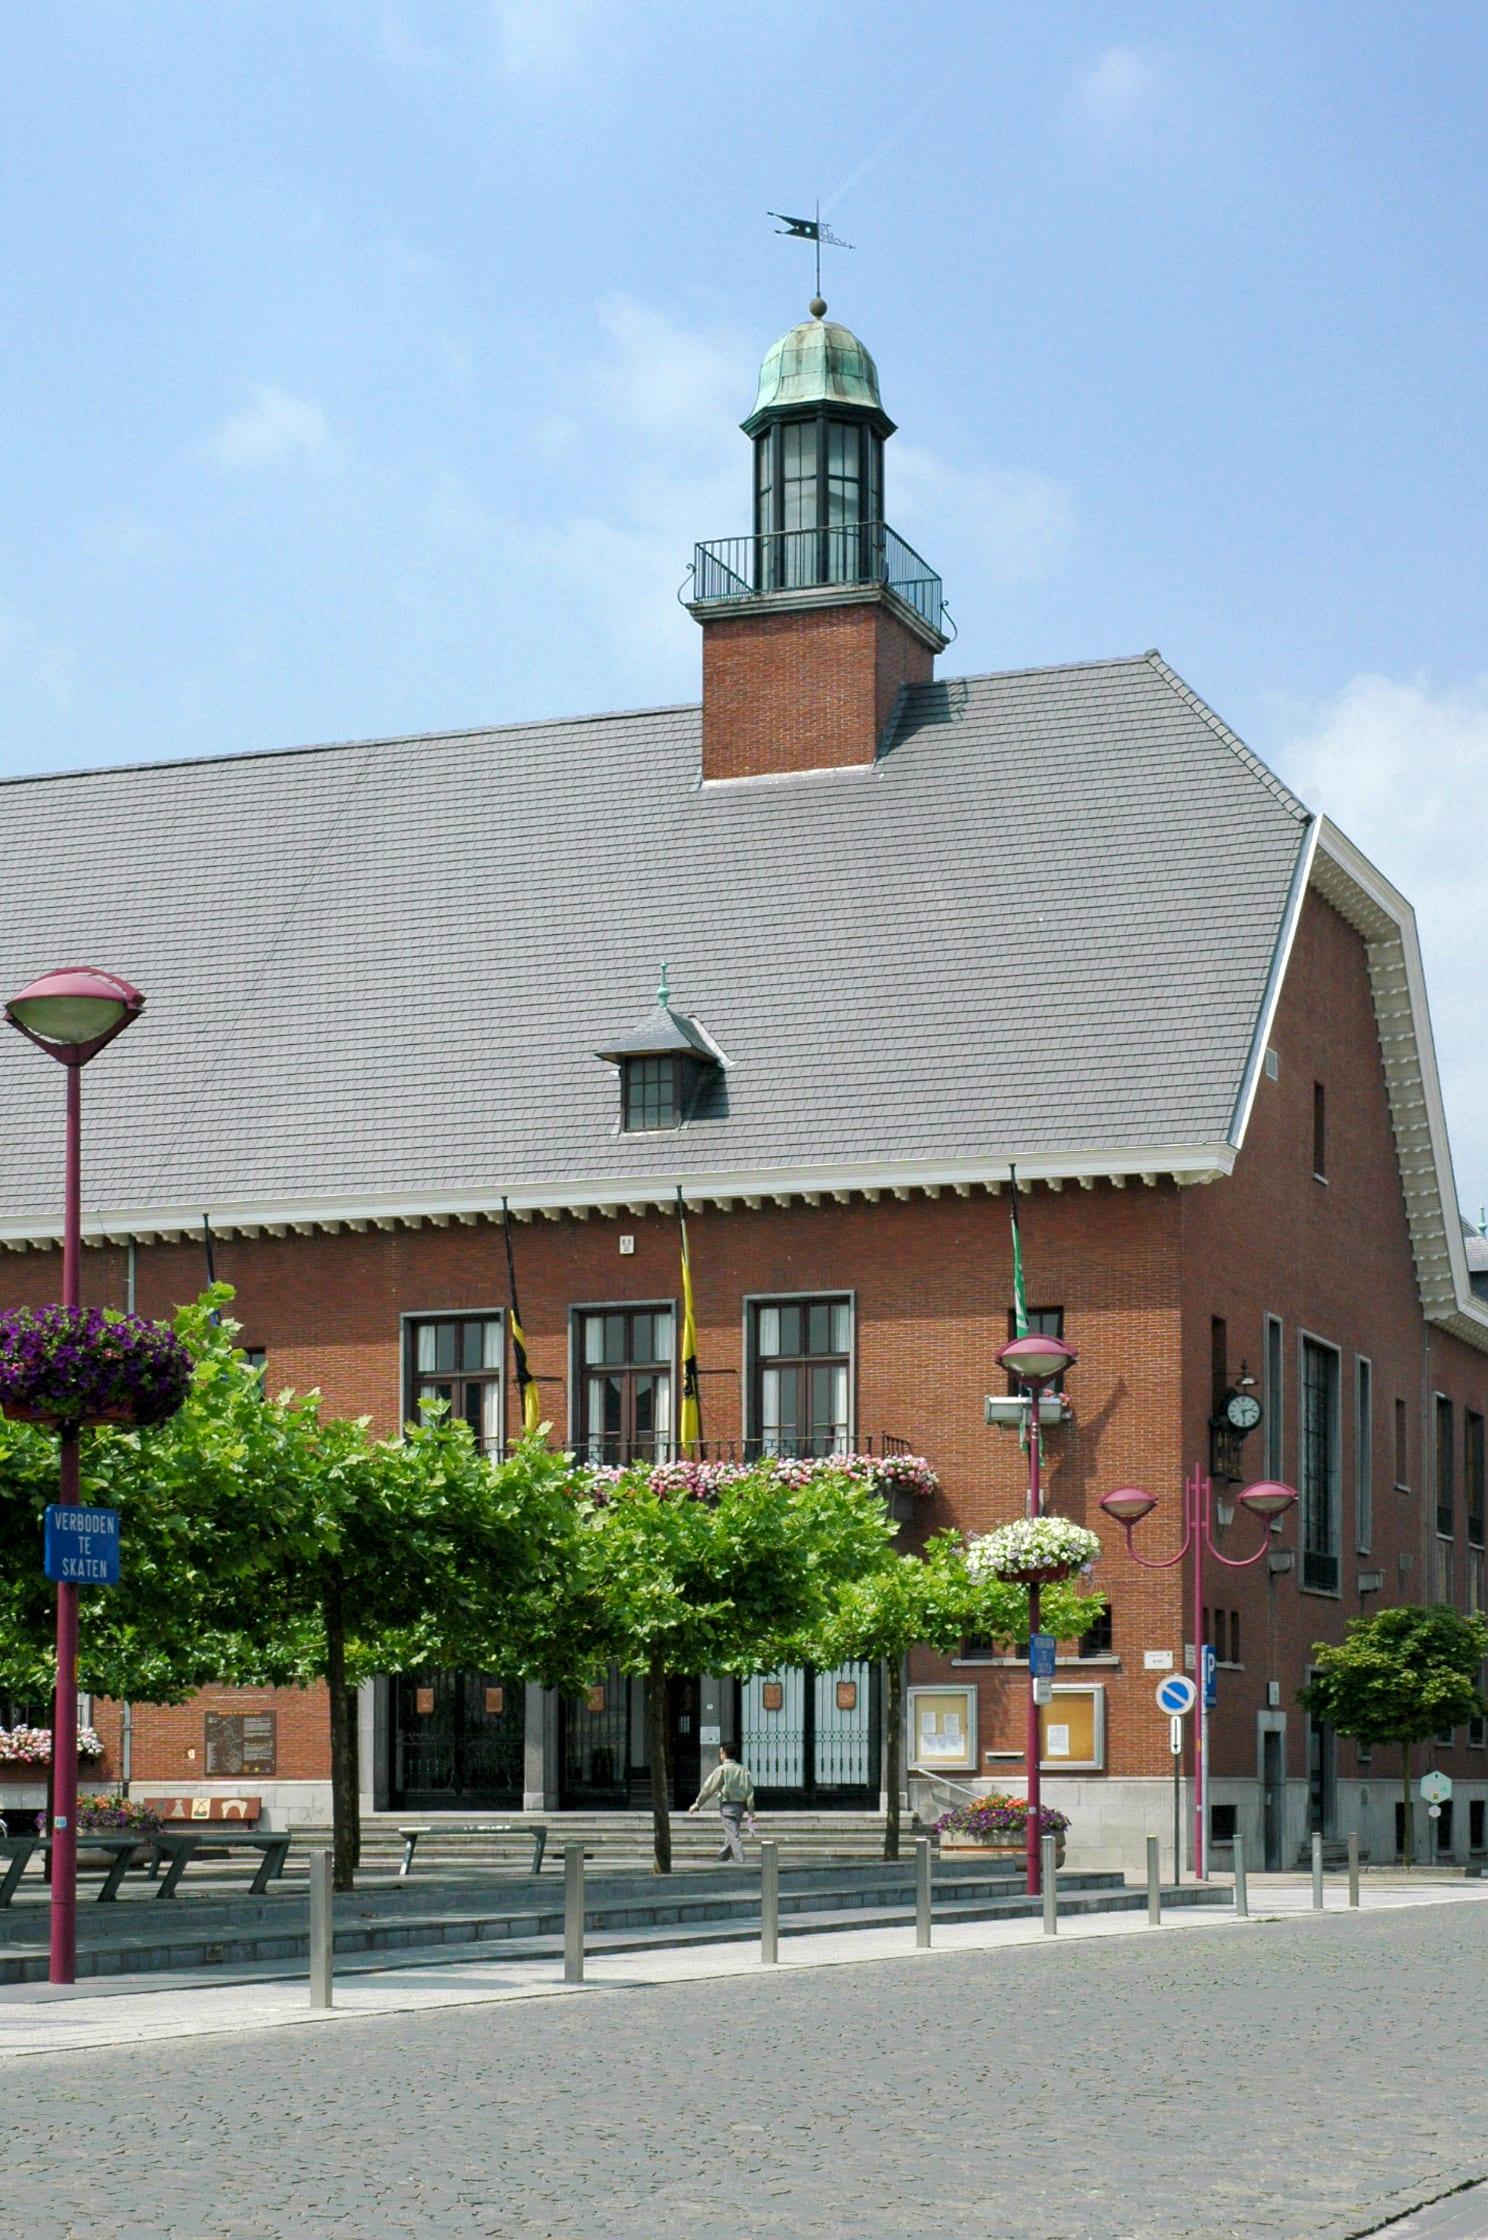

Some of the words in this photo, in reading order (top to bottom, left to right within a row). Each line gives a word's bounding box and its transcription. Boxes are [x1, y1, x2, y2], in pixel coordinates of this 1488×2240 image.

[54, 1511, 115, 1534] VERBODEN
[77, 1535, 92, 1555] TE
[62, 1557, 108, 1578] SKATEN
[1207, 1653, 1215, 1684] P
